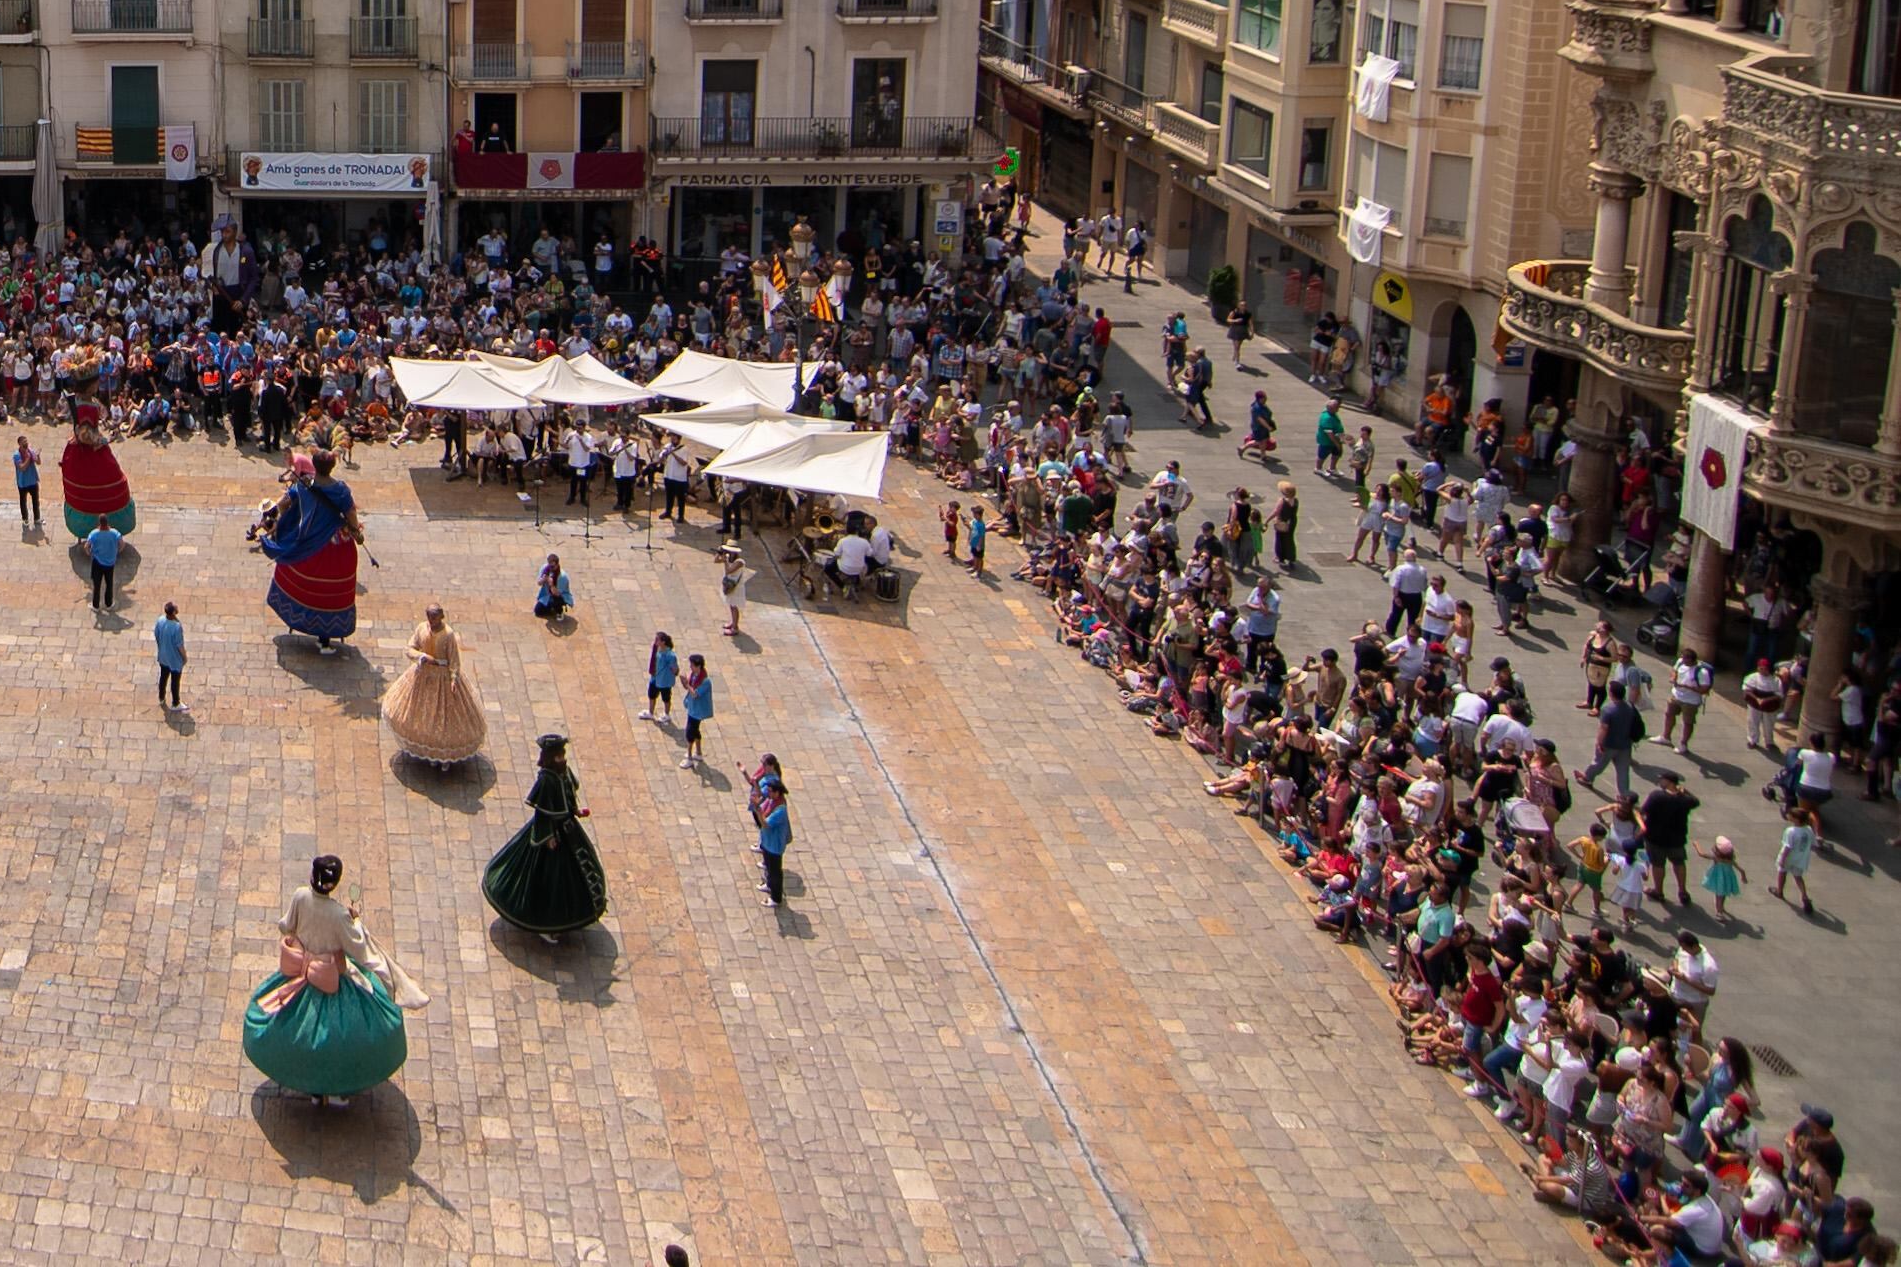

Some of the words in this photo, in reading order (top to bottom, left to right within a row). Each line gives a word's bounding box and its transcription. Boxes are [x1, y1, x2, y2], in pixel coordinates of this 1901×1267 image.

[266, 163, 292, 174] Amb
[294, 164, 326, 177] ganes
[328, 163, 343, 174] de
[344, 164, 406, 175] TRONADA!
[679, 174, 772, 185] FARMACIA
[803, 173, 924, 184] MONTEVERDE
